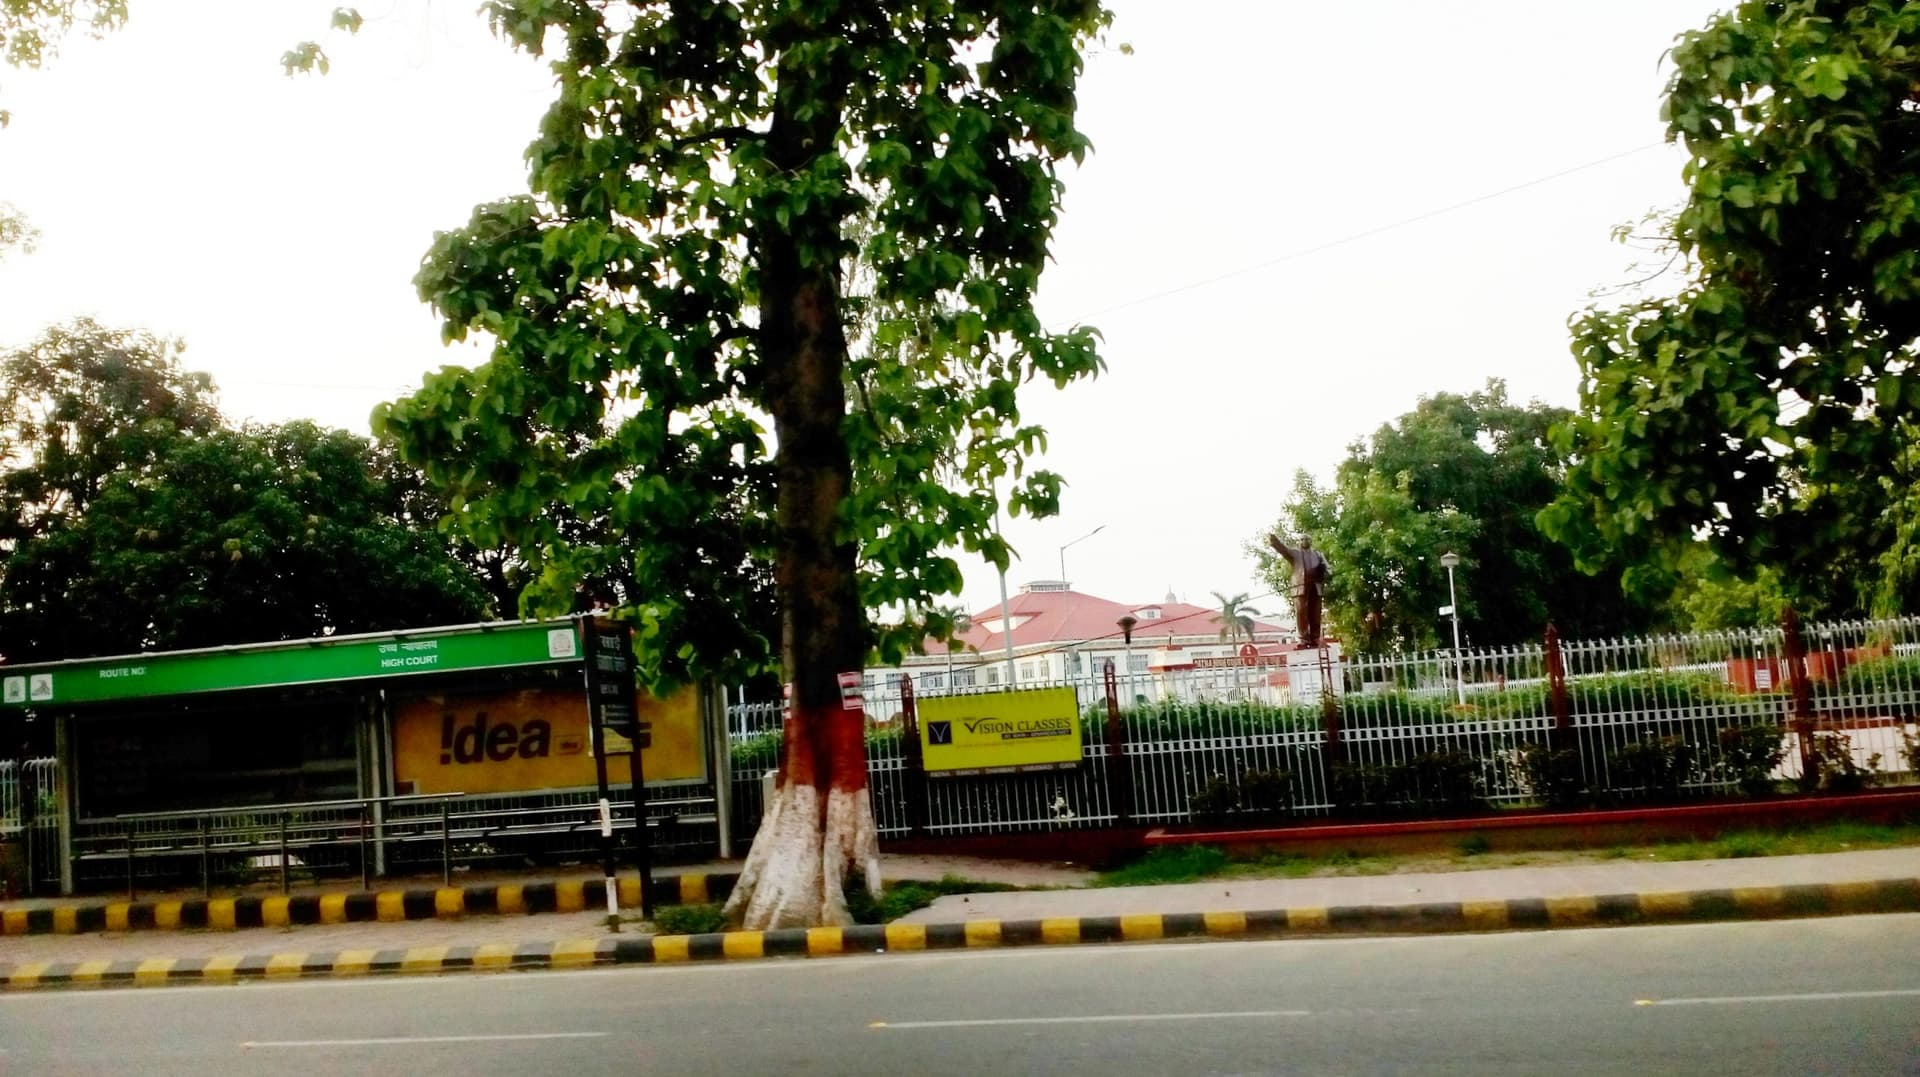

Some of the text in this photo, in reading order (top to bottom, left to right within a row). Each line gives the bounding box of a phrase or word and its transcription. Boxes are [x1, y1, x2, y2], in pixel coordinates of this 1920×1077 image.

[381, 655, 438, 668] HIGH COURT
[99, 667, 129, 678] ROUTE
[964, 717, 1013, 735] VISION
[1017, 718, 1072, 732] CLASSES
